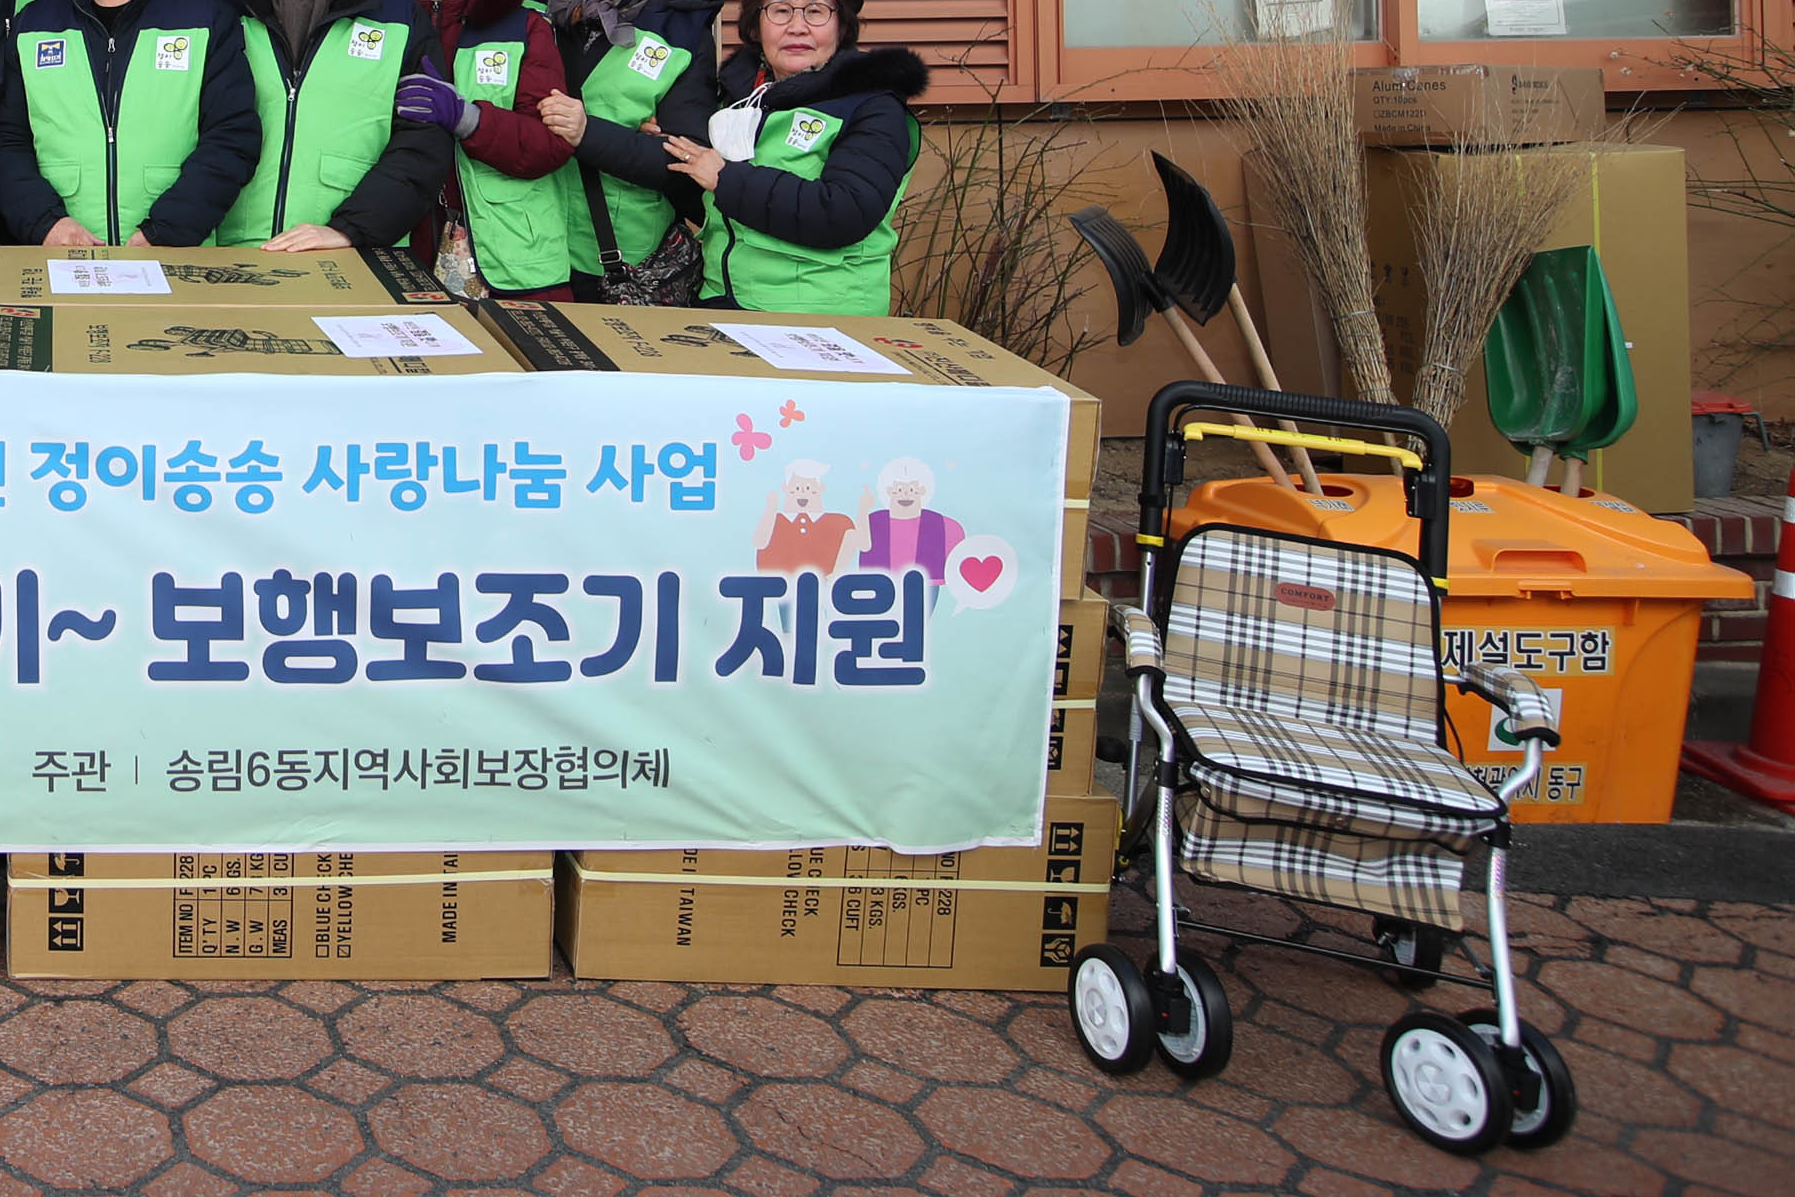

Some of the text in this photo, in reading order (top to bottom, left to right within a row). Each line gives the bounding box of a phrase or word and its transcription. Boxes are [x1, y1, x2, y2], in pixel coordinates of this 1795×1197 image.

[1372, 80, 1446, 92] Alum Canes
[29, 439, 283, 513] 정이송송
[302, 440, 566, 511] 사랑나눔
[585, 441, 718, 511] 사업
[1280, 588, 1332, 602] COMFORT
[147, 569, 683, 685] 보행보조기
[715, 569, 927, 687] 지원
[1440, 629, 1613, 674] 제설도구함
[31, 747, 671, 793] 주관 송림6동지역사회보장협의체
[1546, 767, 1584, 801] 동구
[443, 882, 457, 898] IN
[179, 903, 194, 921] NO
[316, 907, 331, 942] BLUE
[337, 886, 353, 942] YELLOW
[442, 901, 457, 943] MADE
[676, 887, 695, 947] TAIWAN
[780, 888, 799, 938] CHECK
[845, 899, 860, 932] CUFT
[868, 898, 884, 930] KGS.
[179, 923, 193, 954] ITEM
[273, 919, 287, 954] MEAS
